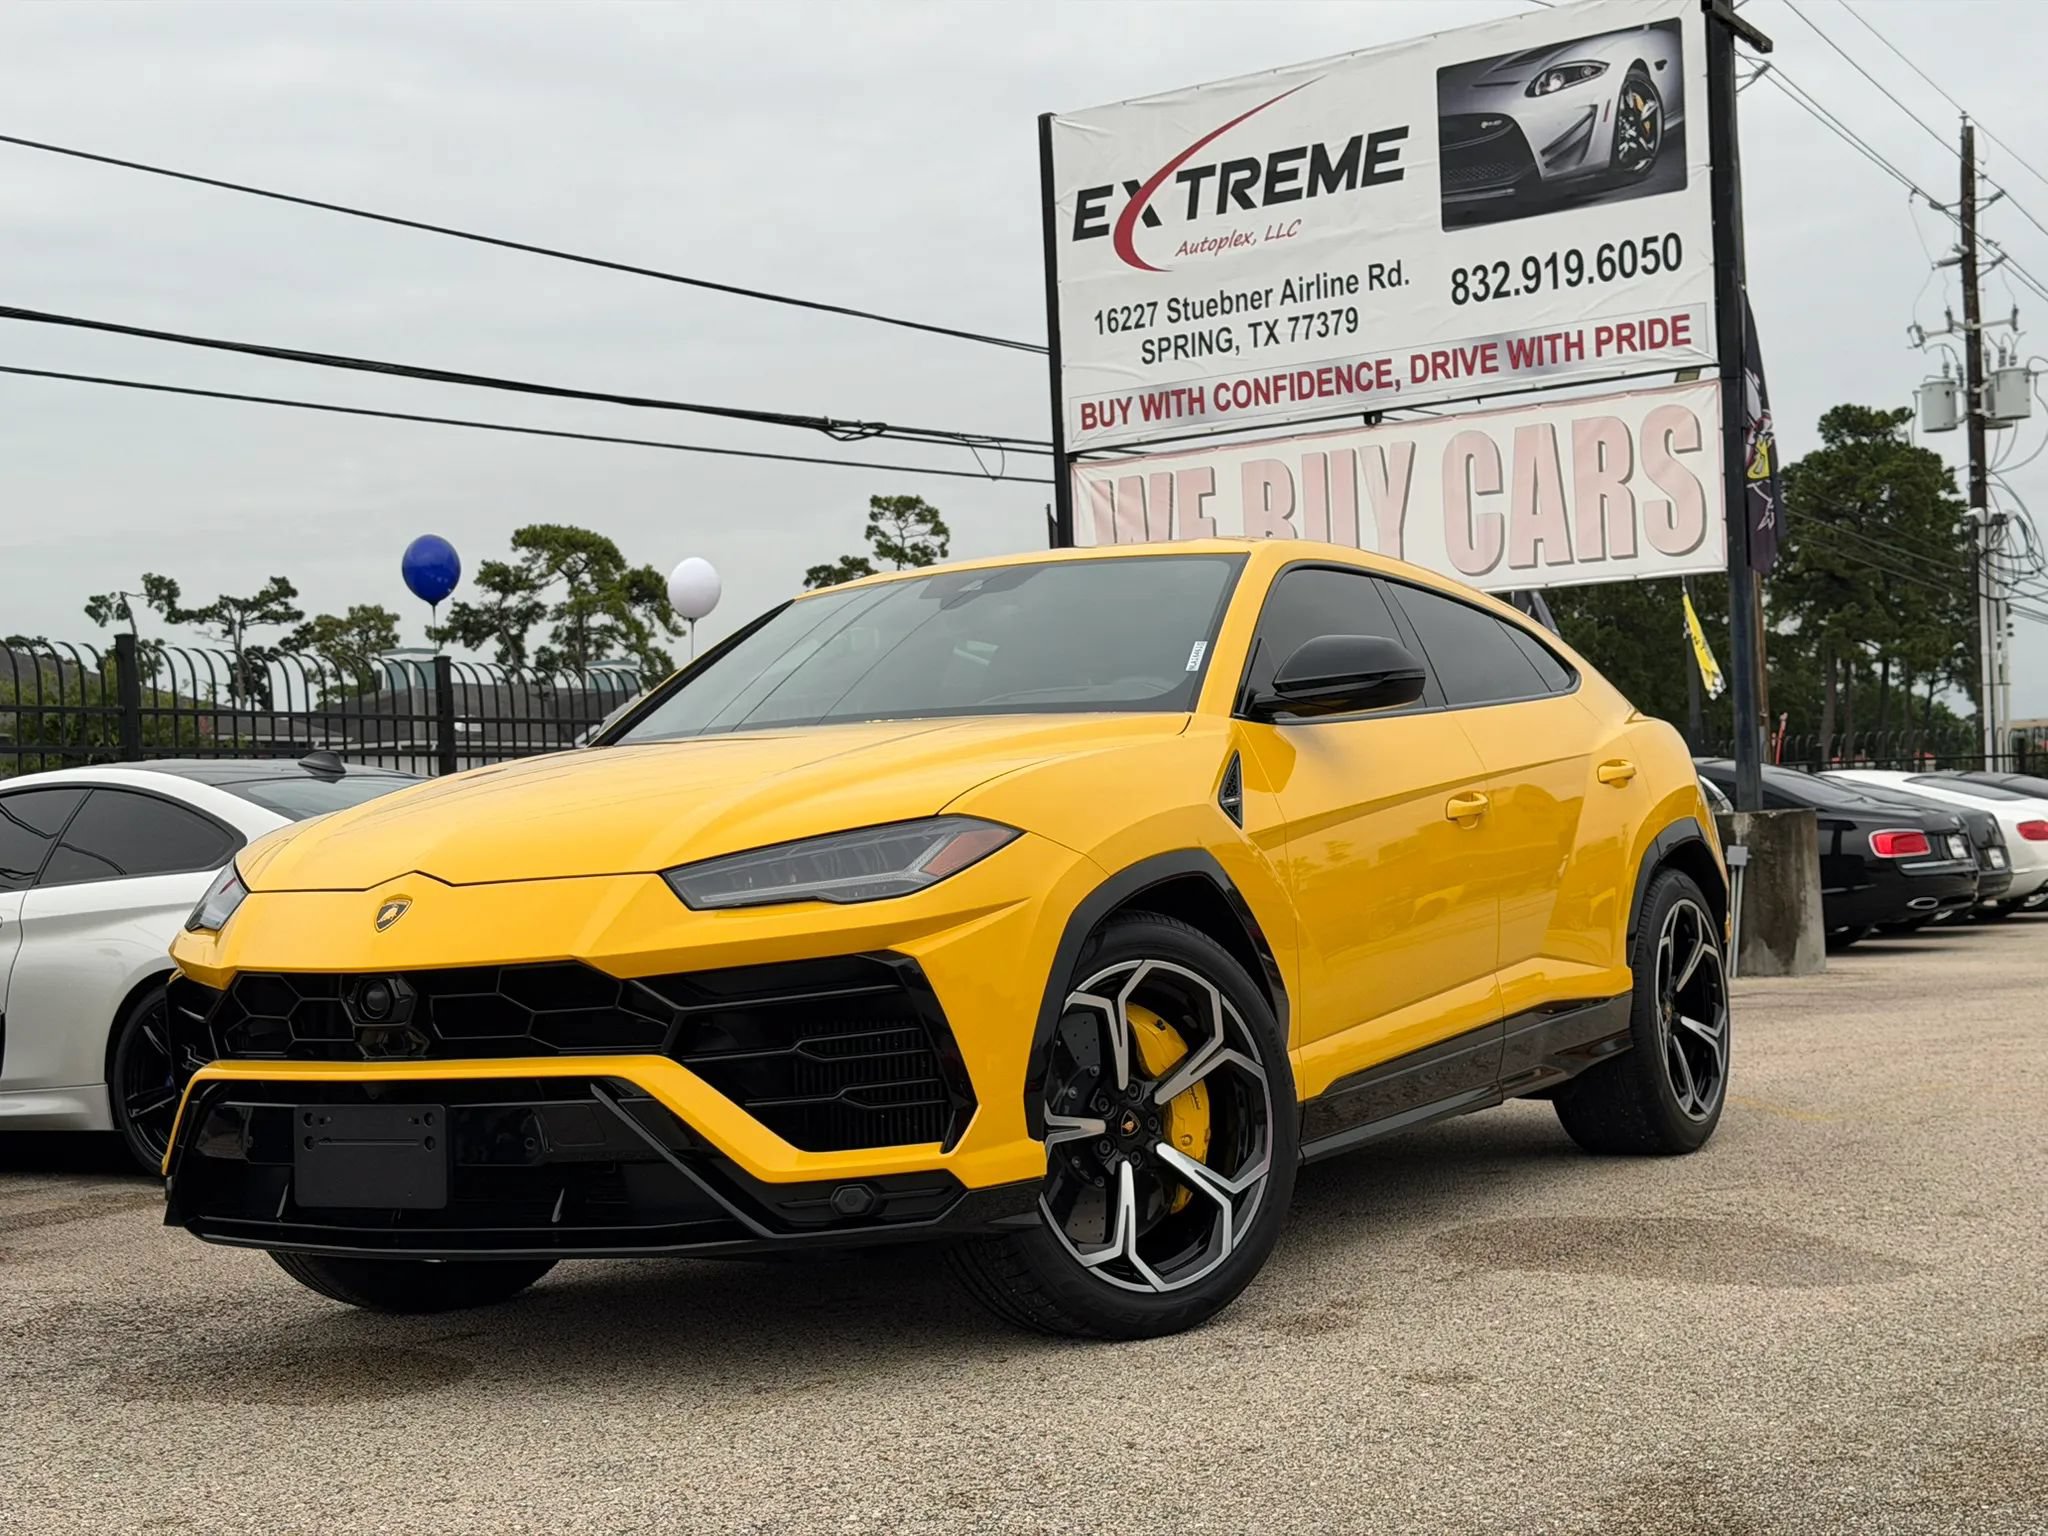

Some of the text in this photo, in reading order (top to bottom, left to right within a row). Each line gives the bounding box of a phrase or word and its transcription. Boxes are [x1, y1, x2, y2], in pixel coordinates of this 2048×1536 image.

[1072, 125, 1410, 242] EXTREME
[1174, 218, 1302, 257] Autoplex, LLC
[1450, 231, 1683, 306] 832.919.6050
[1094, 259, 1410, 335] 16227 Stuebner Airline Rd.
[1081, 313, 1692, 431] BUY WITH CONFIDENCE, DRIVE WITH PRIDE
[1141, 306, 1359, 365] SPRING, TX 77379
[1441, 403, 1704, 577] CARS
